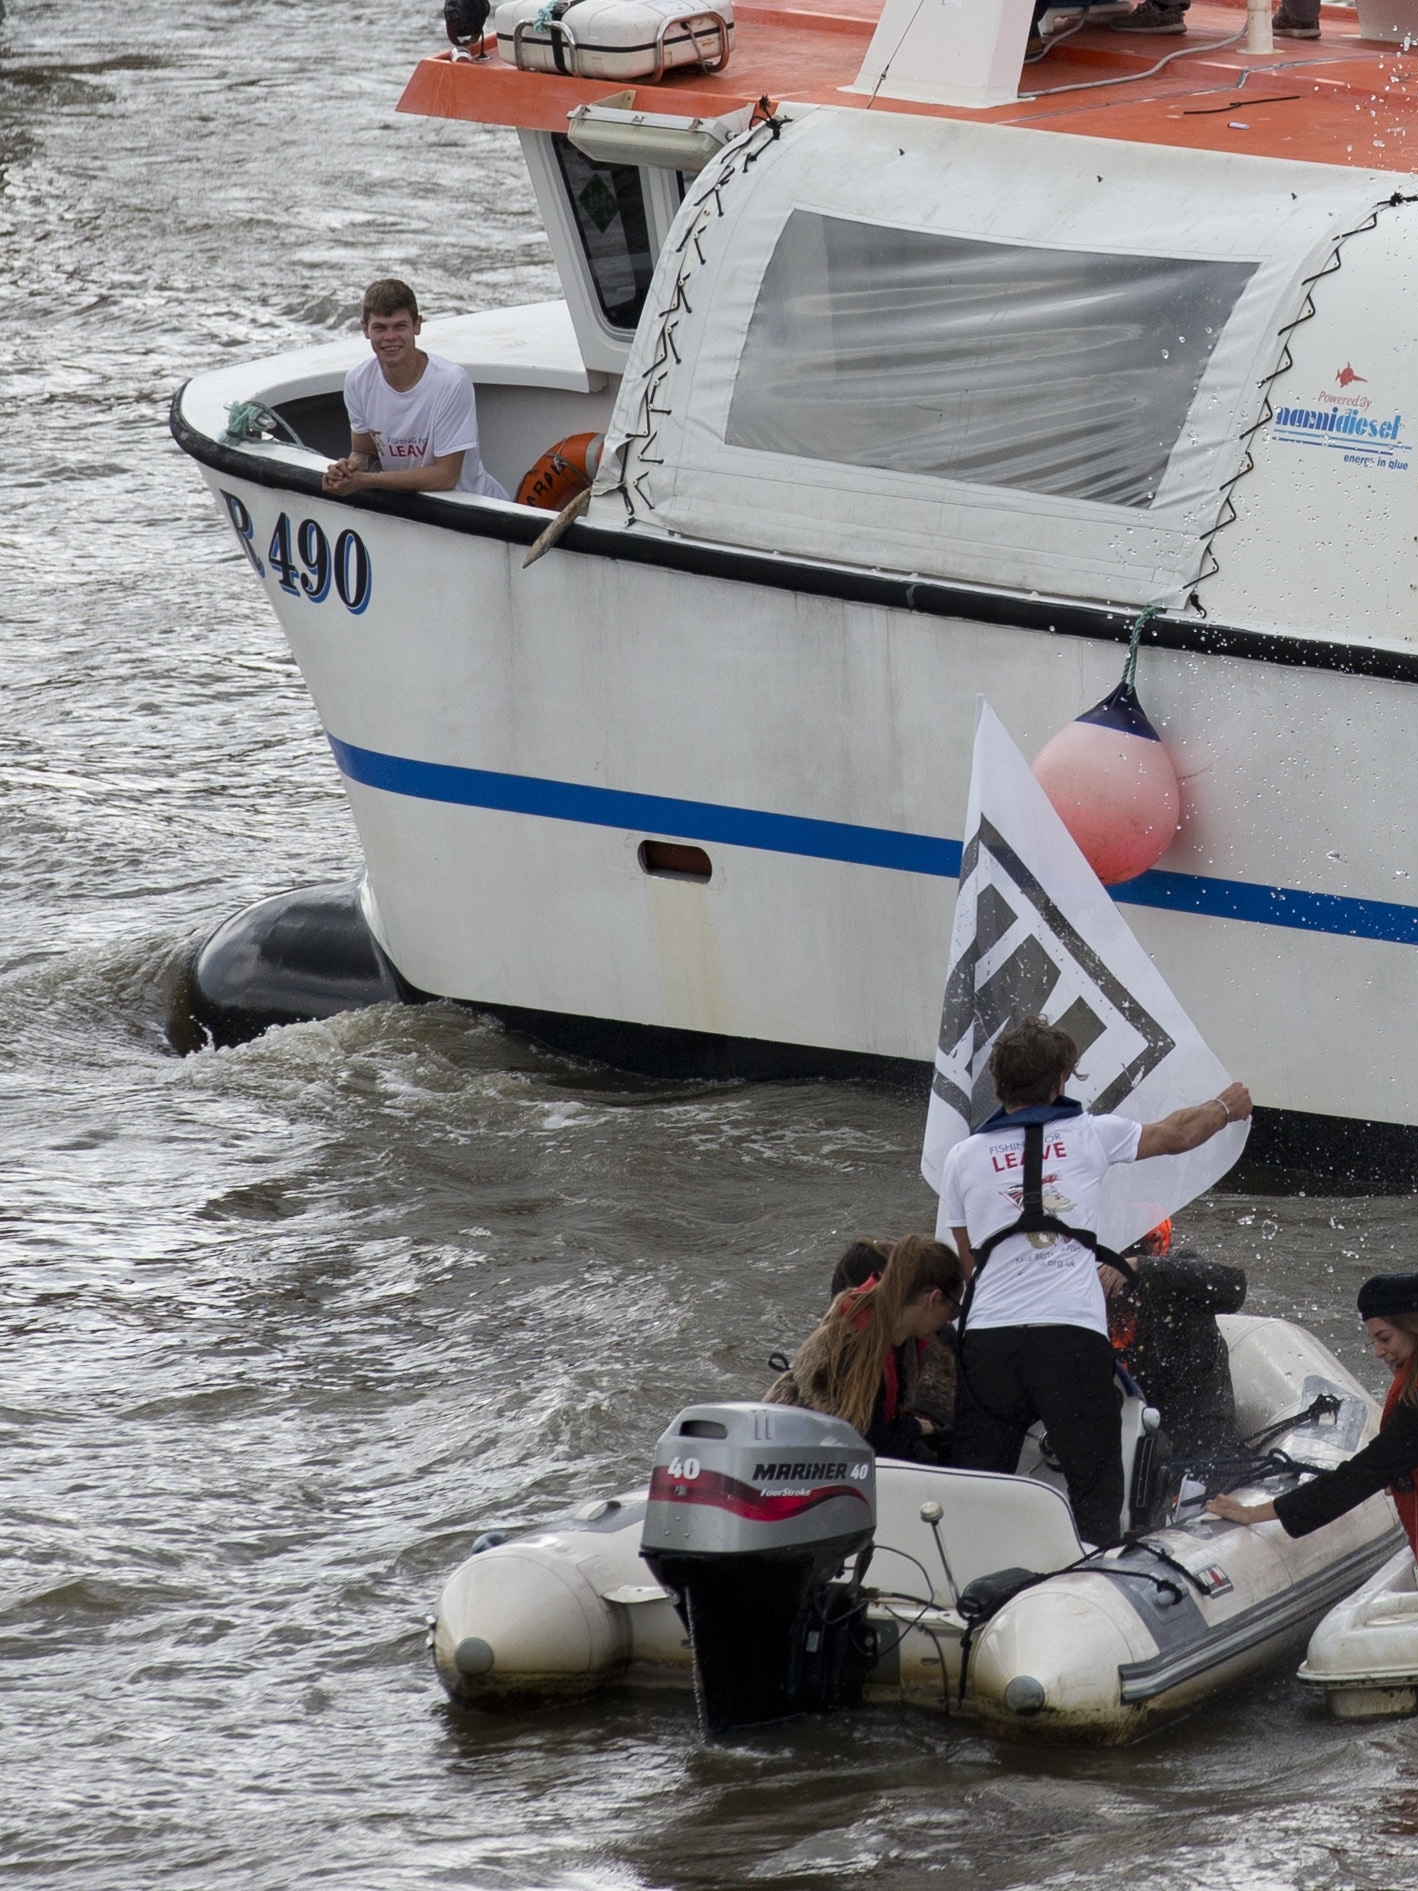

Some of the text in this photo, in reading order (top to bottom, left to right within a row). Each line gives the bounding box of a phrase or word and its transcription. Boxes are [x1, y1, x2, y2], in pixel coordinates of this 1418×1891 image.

[1318, 391, 1361, 407] Powered
[1276, 406, 1402, 440] nannidiesel
[388, 444, 429, 458] LEAV
[1377, 456, 1386, 467] in
[219, 488, 372, 615] R 490
[989, 1141, 1025, 1155] FISHIN
[668, 1456, 869, 1481] 40 MARINER 40
[760, 1487, 812, 1497] FourStroke
